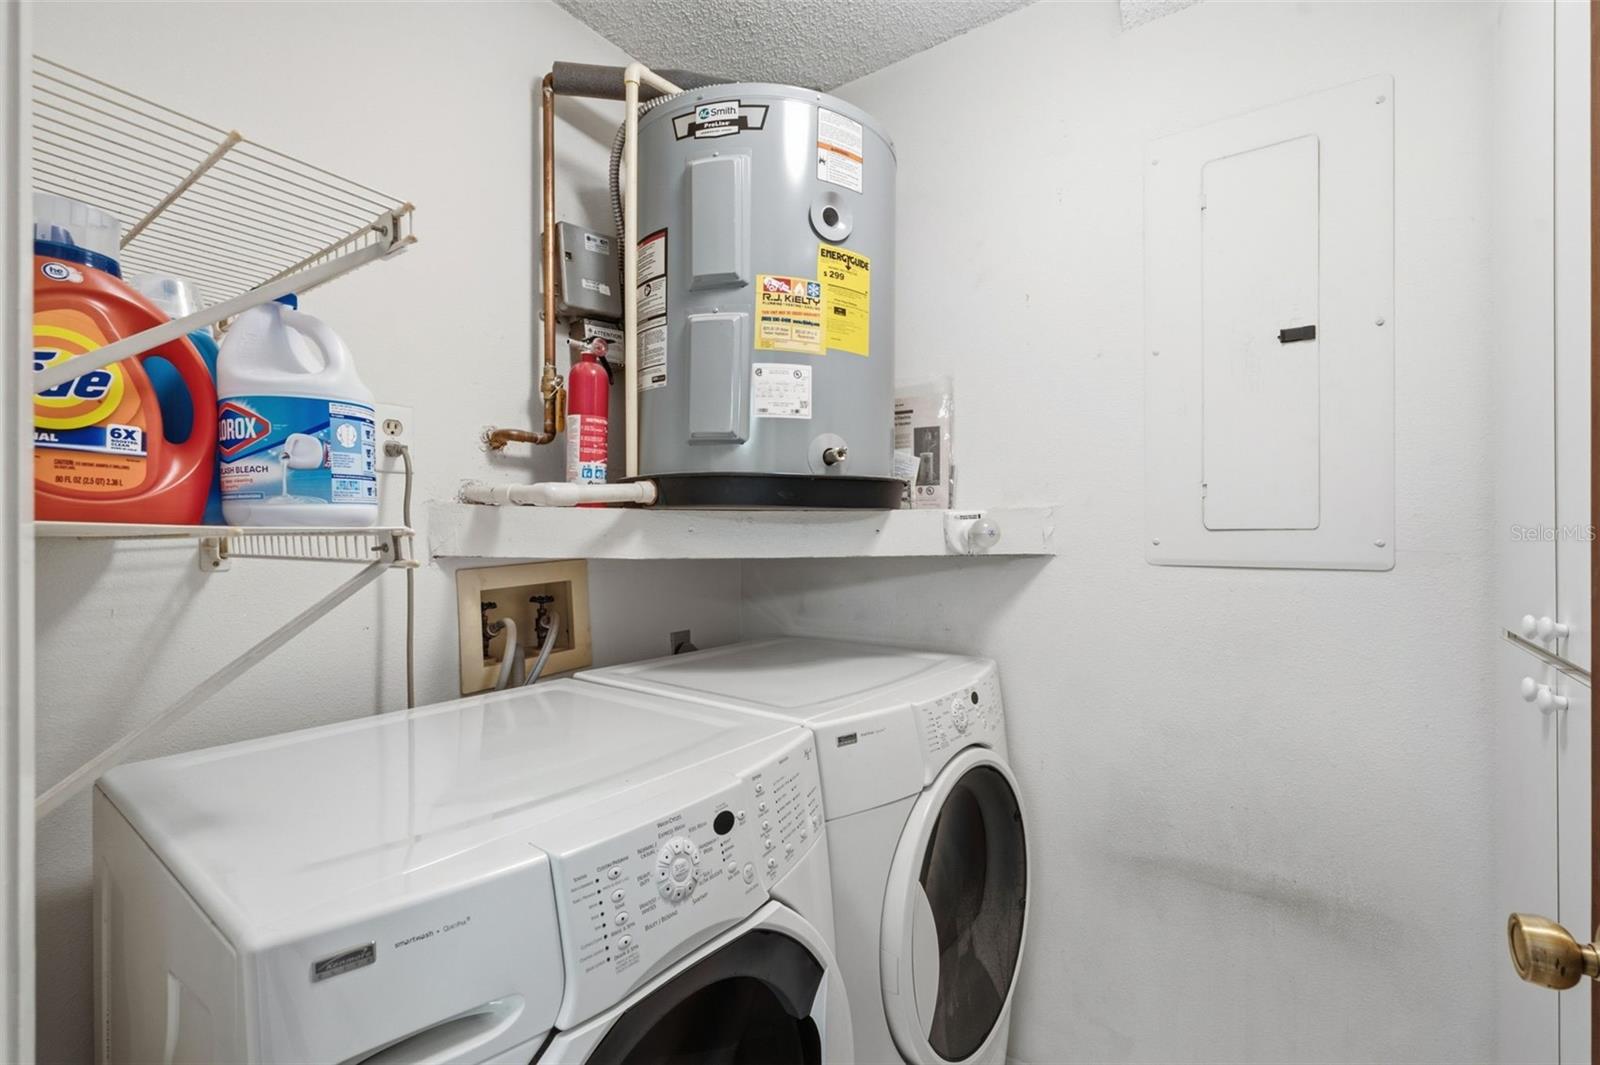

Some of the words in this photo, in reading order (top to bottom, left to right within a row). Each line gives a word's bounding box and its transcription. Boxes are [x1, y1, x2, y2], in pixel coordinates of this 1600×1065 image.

[710, 106, 736, 116] Smith
[829, 270, 844, 280] 299
[762, 293, 782, 302] R.J.
[110, 428, 136, 440] 6X
[236, 465, 269, 474] BLEACH
